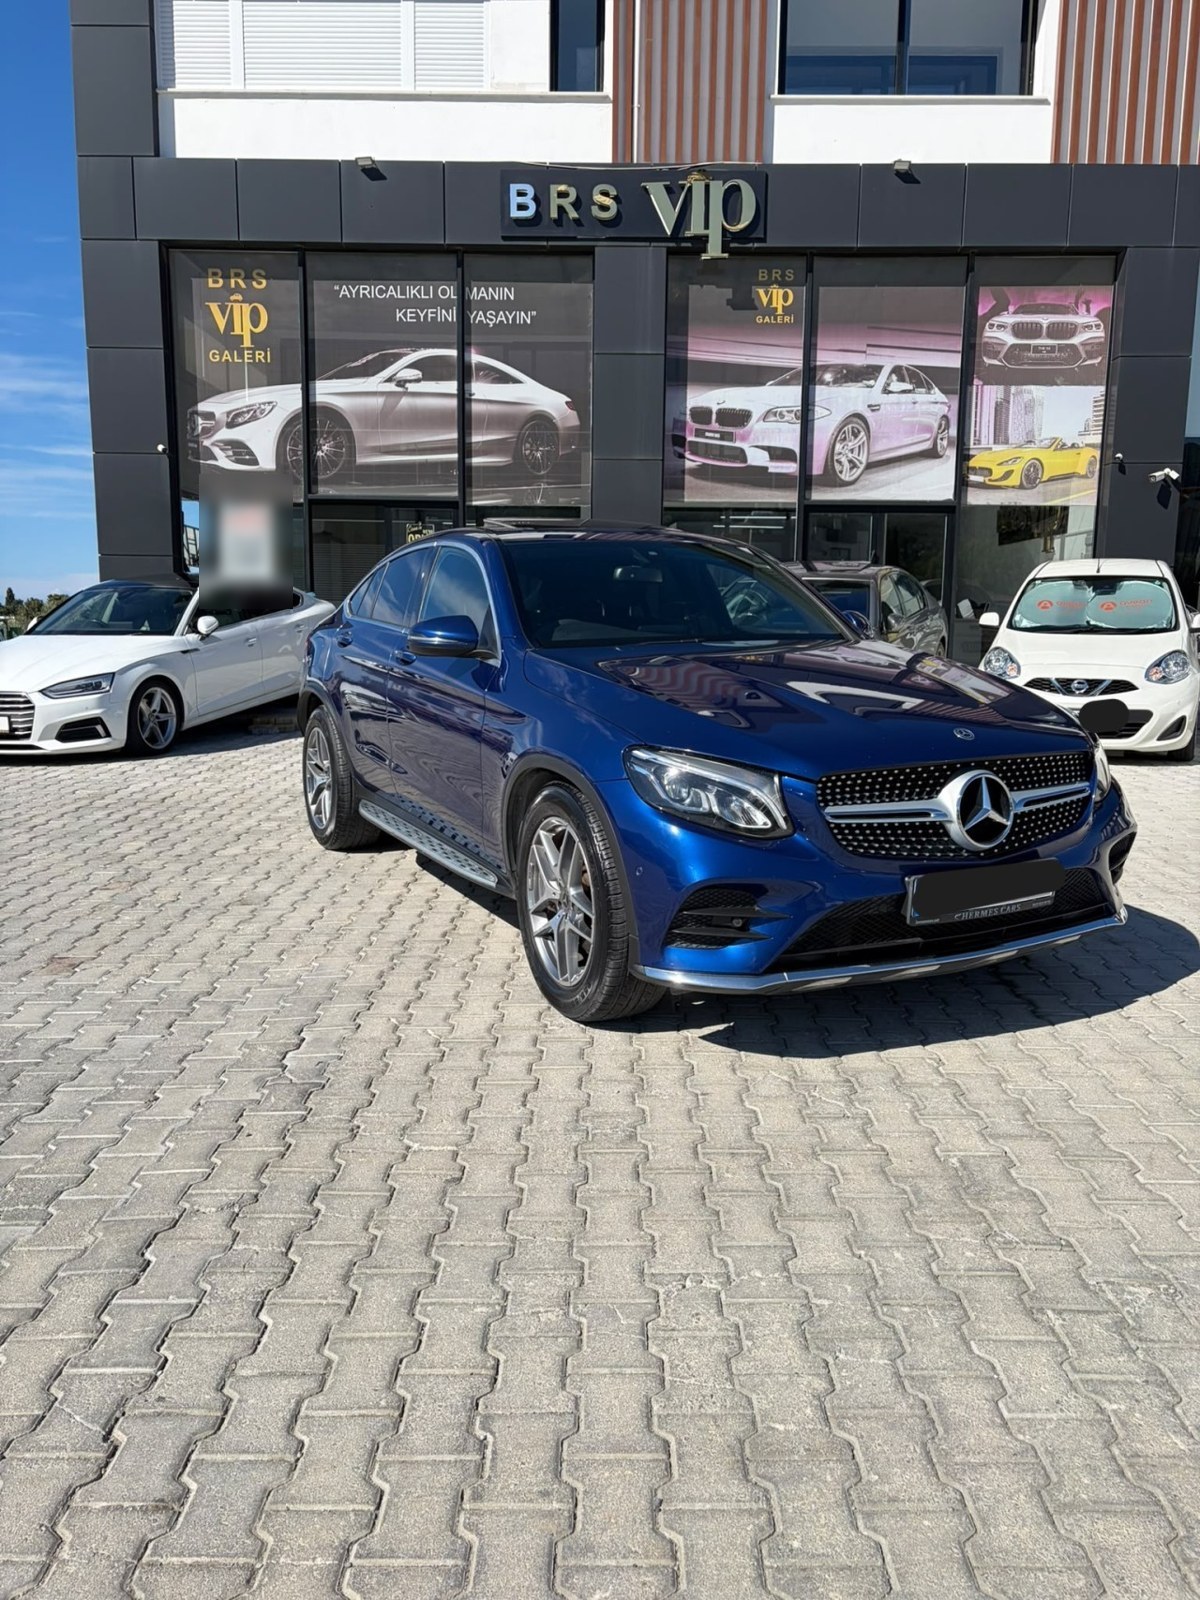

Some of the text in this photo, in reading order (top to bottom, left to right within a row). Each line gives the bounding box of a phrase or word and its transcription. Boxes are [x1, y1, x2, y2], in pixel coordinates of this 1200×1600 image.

[509, 183, 618, 221] BRS
[207, 268, 267, 289] BRS
[758, 269, 794, 281] BRS
[209, 347, 271, 363] GALERİ
[1000, 904, 1022, 916] CARS
